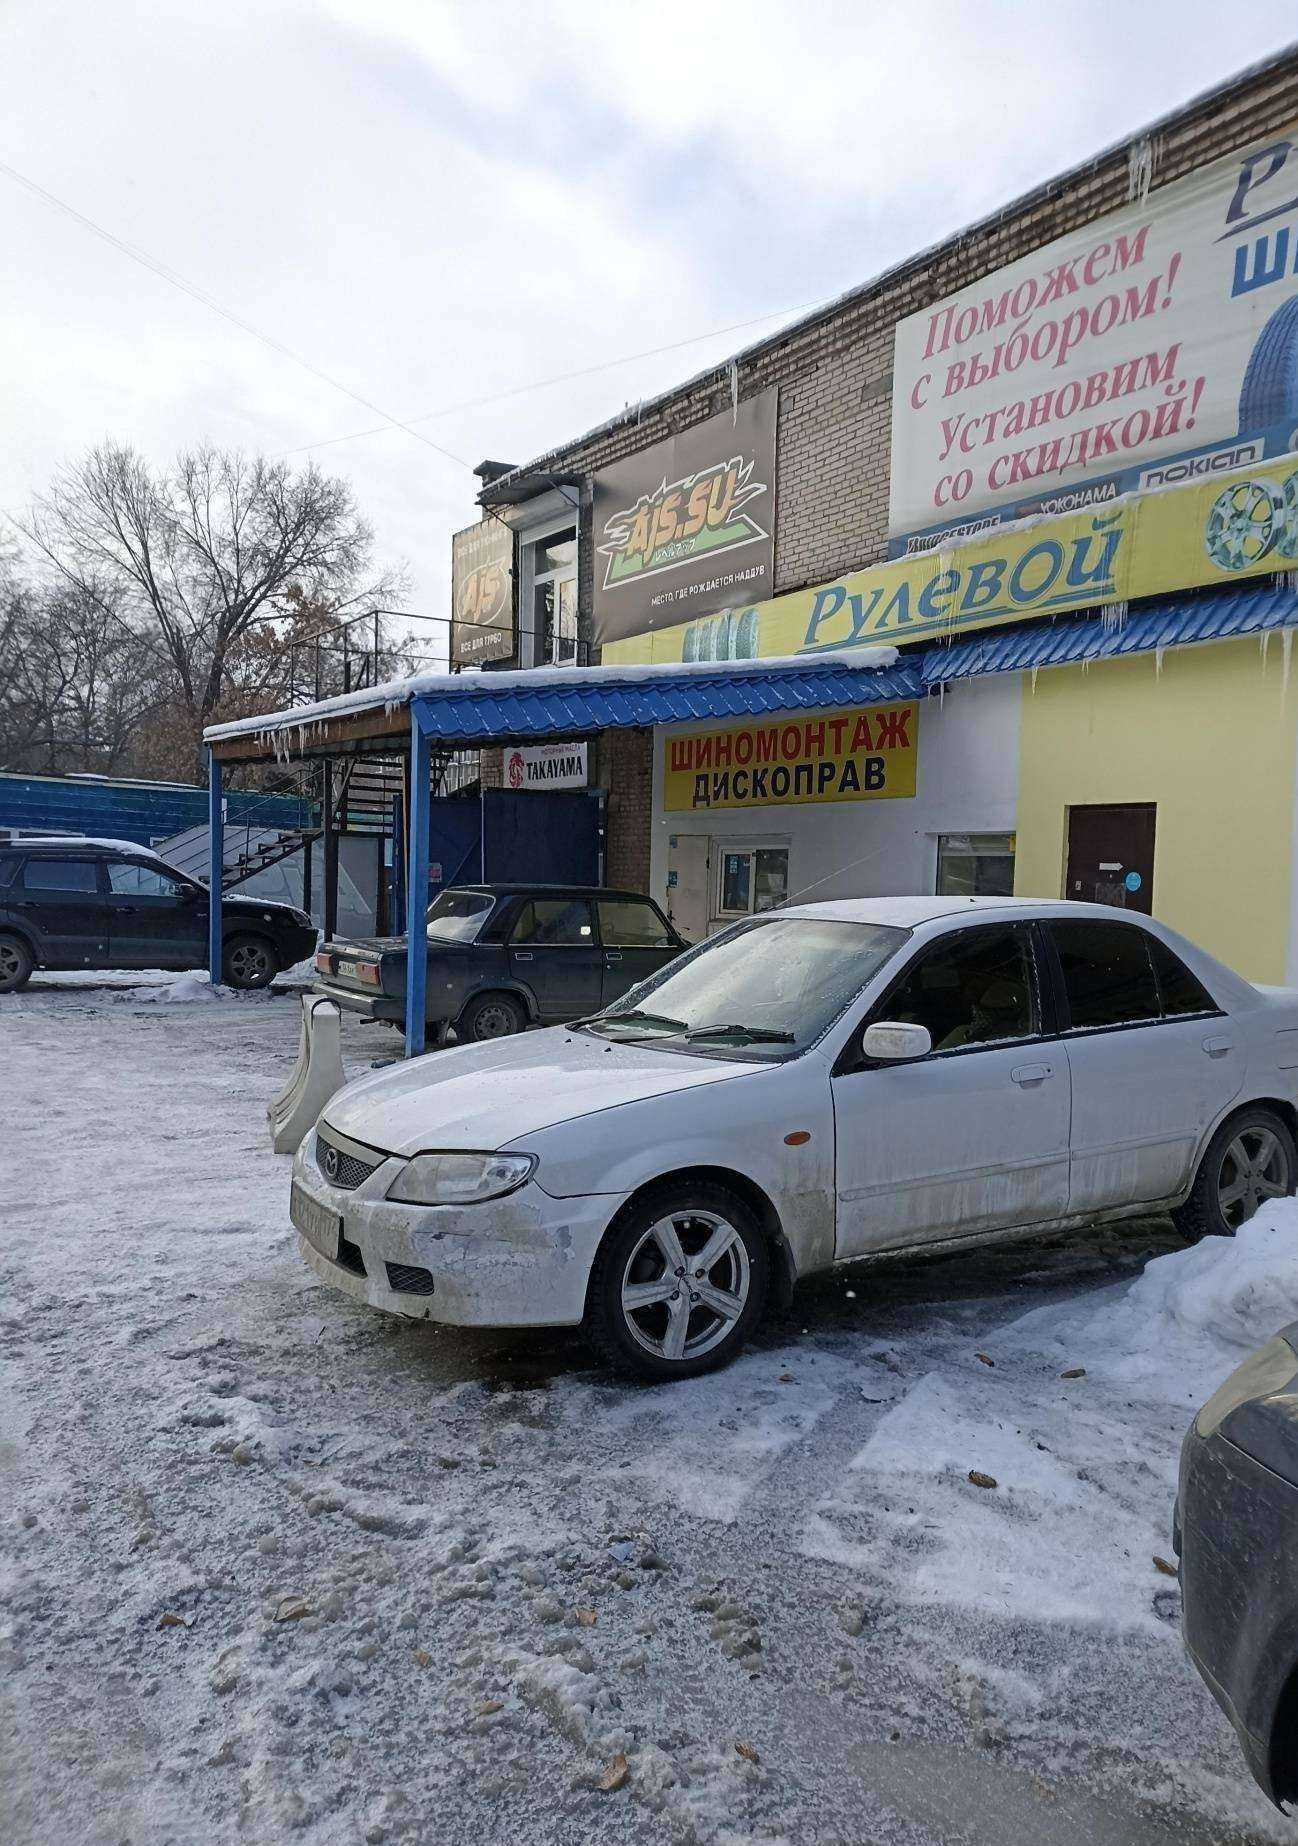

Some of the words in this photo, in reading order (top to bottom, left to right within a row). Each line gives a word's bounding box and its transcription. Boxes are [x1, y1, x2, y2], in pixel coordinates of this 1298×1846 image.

[1225, 141, 1298, 224] Р
[921, 223, 1152, 361] Поможем
[1231, 226, 1298, 298] Ш
[909, 373, 932, 410] с
[942, 251, 1182, 398] выбором!
[937, 341, 1184, 462] Установим
[933, 467, 974, 508] со
[987, 375, 1206, 490] скидкой!
[1040, 482, 1117, 515] YOKOHAMA
[674, 588, 688, 600] ГДЕ
[689, 574, 734, 595] РОЖДАЕТСЯ
[735, 565, 765, 581] НАДДУВ
[526, 755, 583, 780] TAKAYAMA
[670, 708, 913, 773] ШИНОМОНТАЖ
[692, 756, 887, 808] ДИСКОПРАВ
